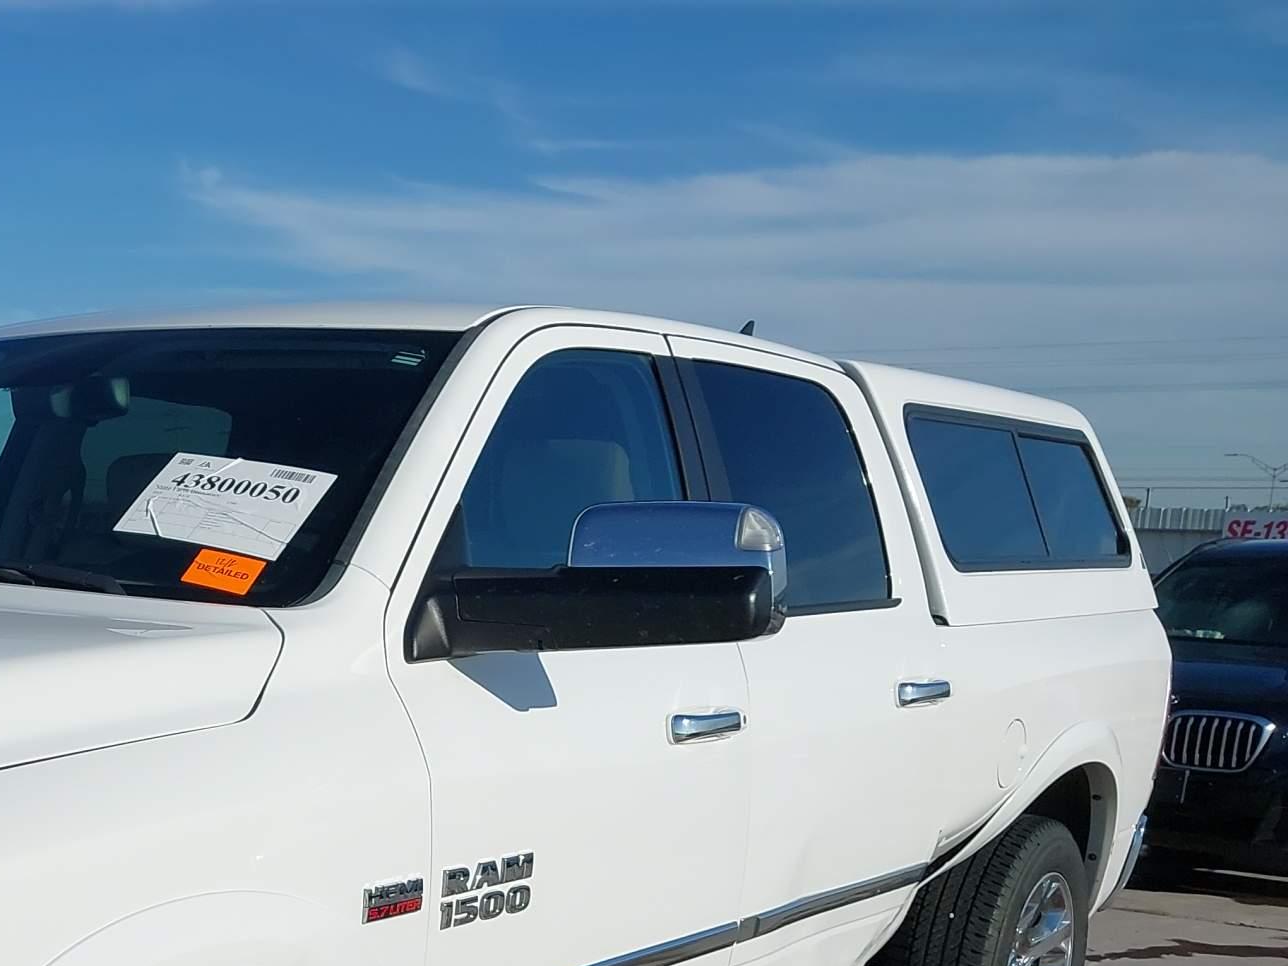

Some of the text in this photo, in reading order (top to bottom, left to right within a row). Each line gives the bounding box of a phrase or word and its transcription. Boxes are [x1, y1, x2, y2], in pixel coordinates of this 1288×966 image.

[171, 472, 300, 504] 43800050
[196, 562, 249, 580] DETAILED
[442, 852, 534, 897] RAM
[363, 878, 424, 907] HEMI
[440, 885, 531, 930] 1500
